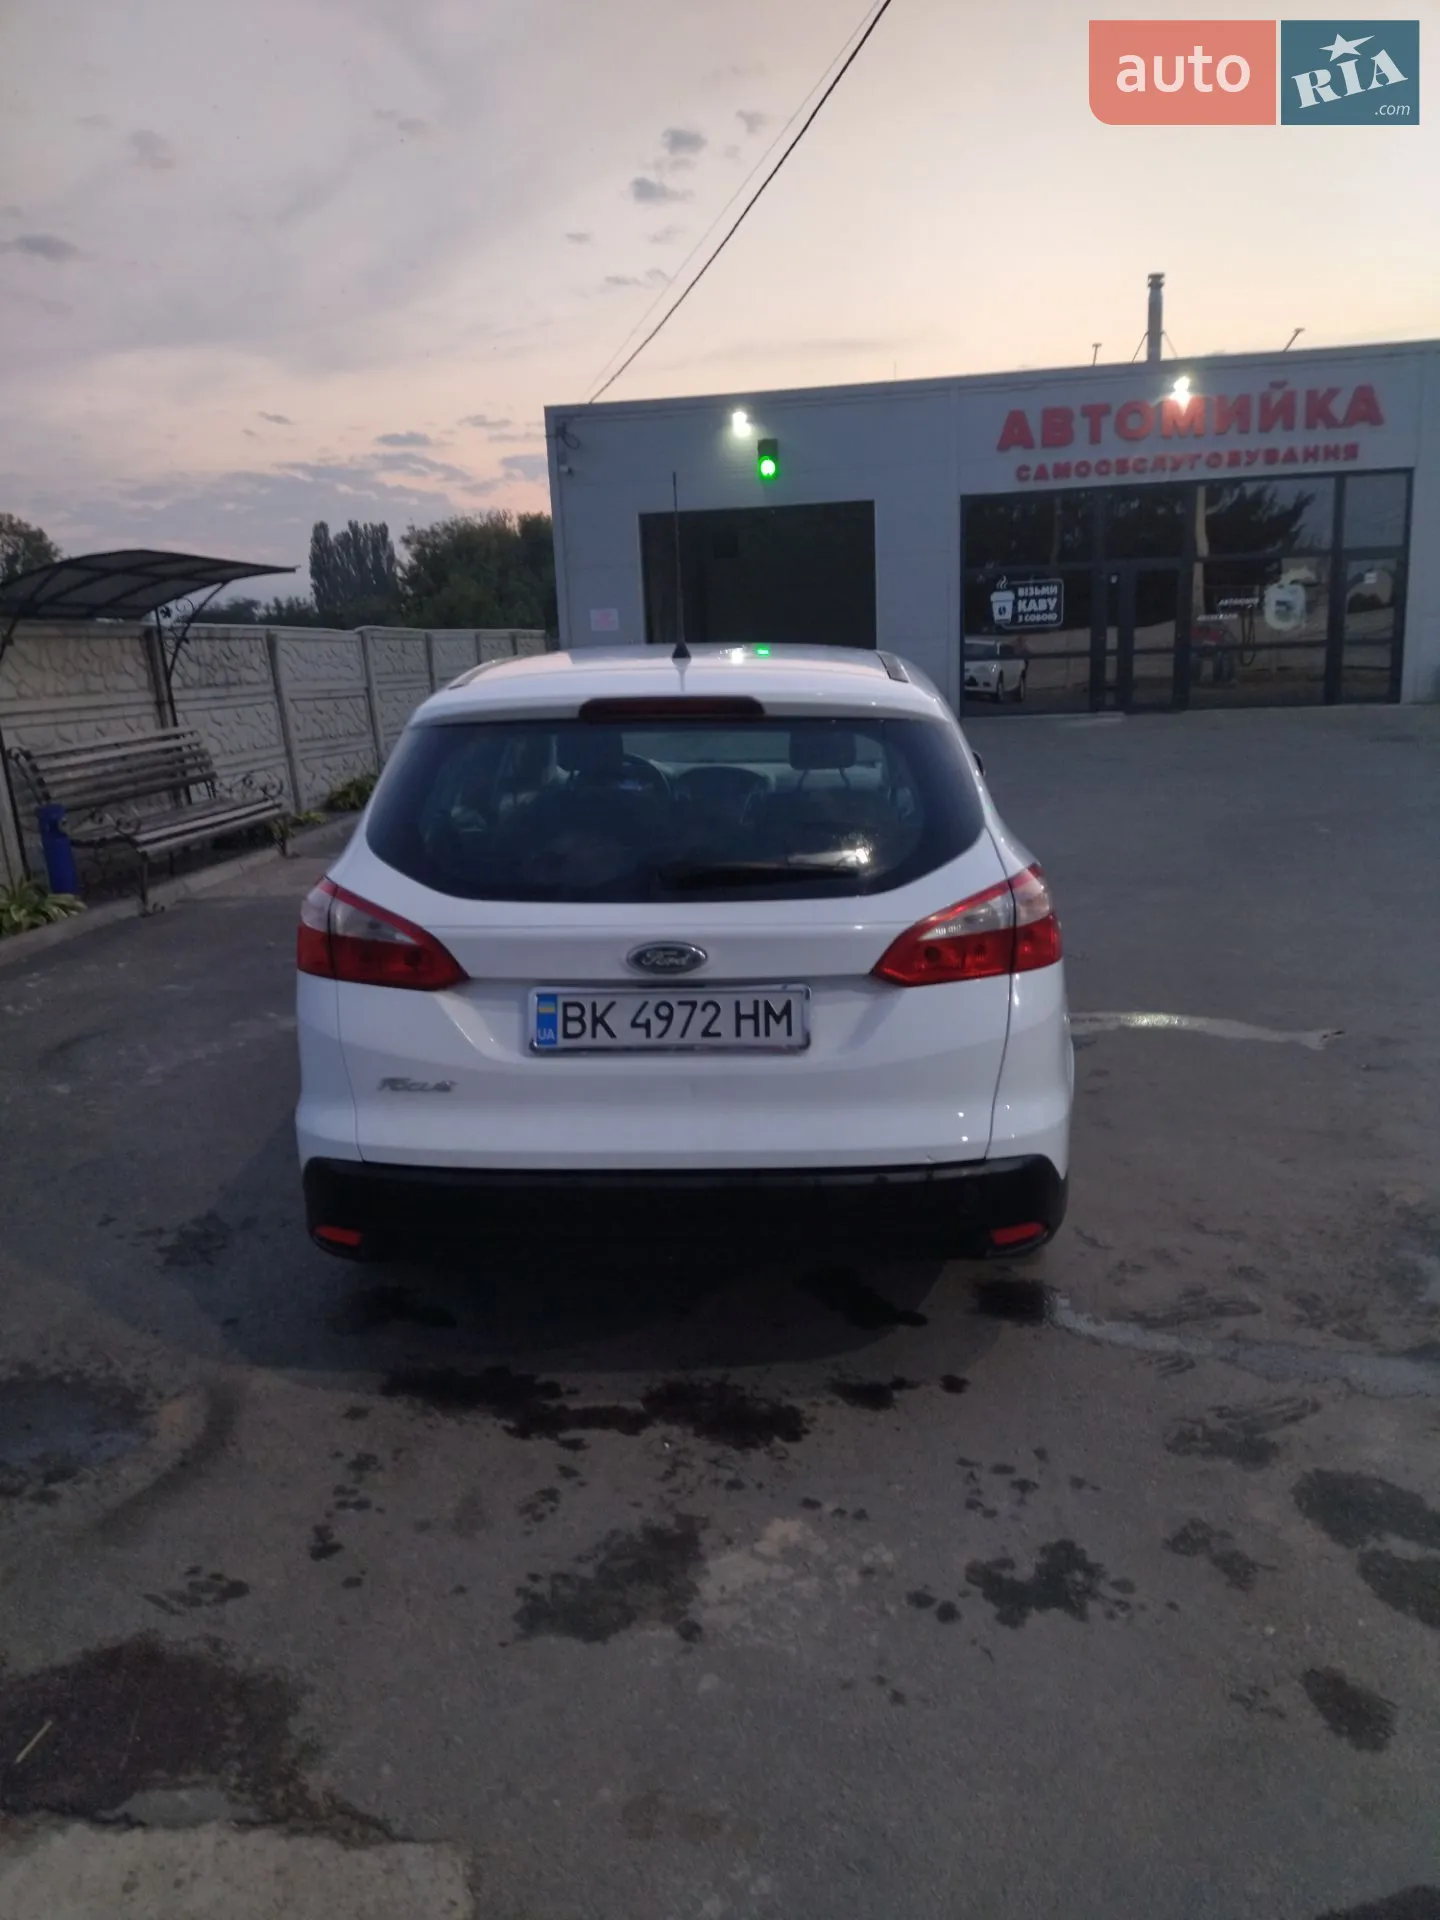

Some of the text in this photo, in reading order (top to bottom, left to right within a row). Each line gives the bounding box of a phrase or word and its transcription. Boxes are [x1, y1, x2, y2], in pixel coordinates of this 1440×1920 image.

[996, 380, 1384, 451] АВТОМИЙКА
[1015, 442, 1360, 482] САМООБСЛУГОВУВАННЯ
[1018, 597, 1058, 612] КАВУ
[641, 950, 691, 966] Ford
[562, 1001, 617, 1039] BK
[630, 1001, 722, 1039] 4972
[735, 999, 793, 1038] HM
